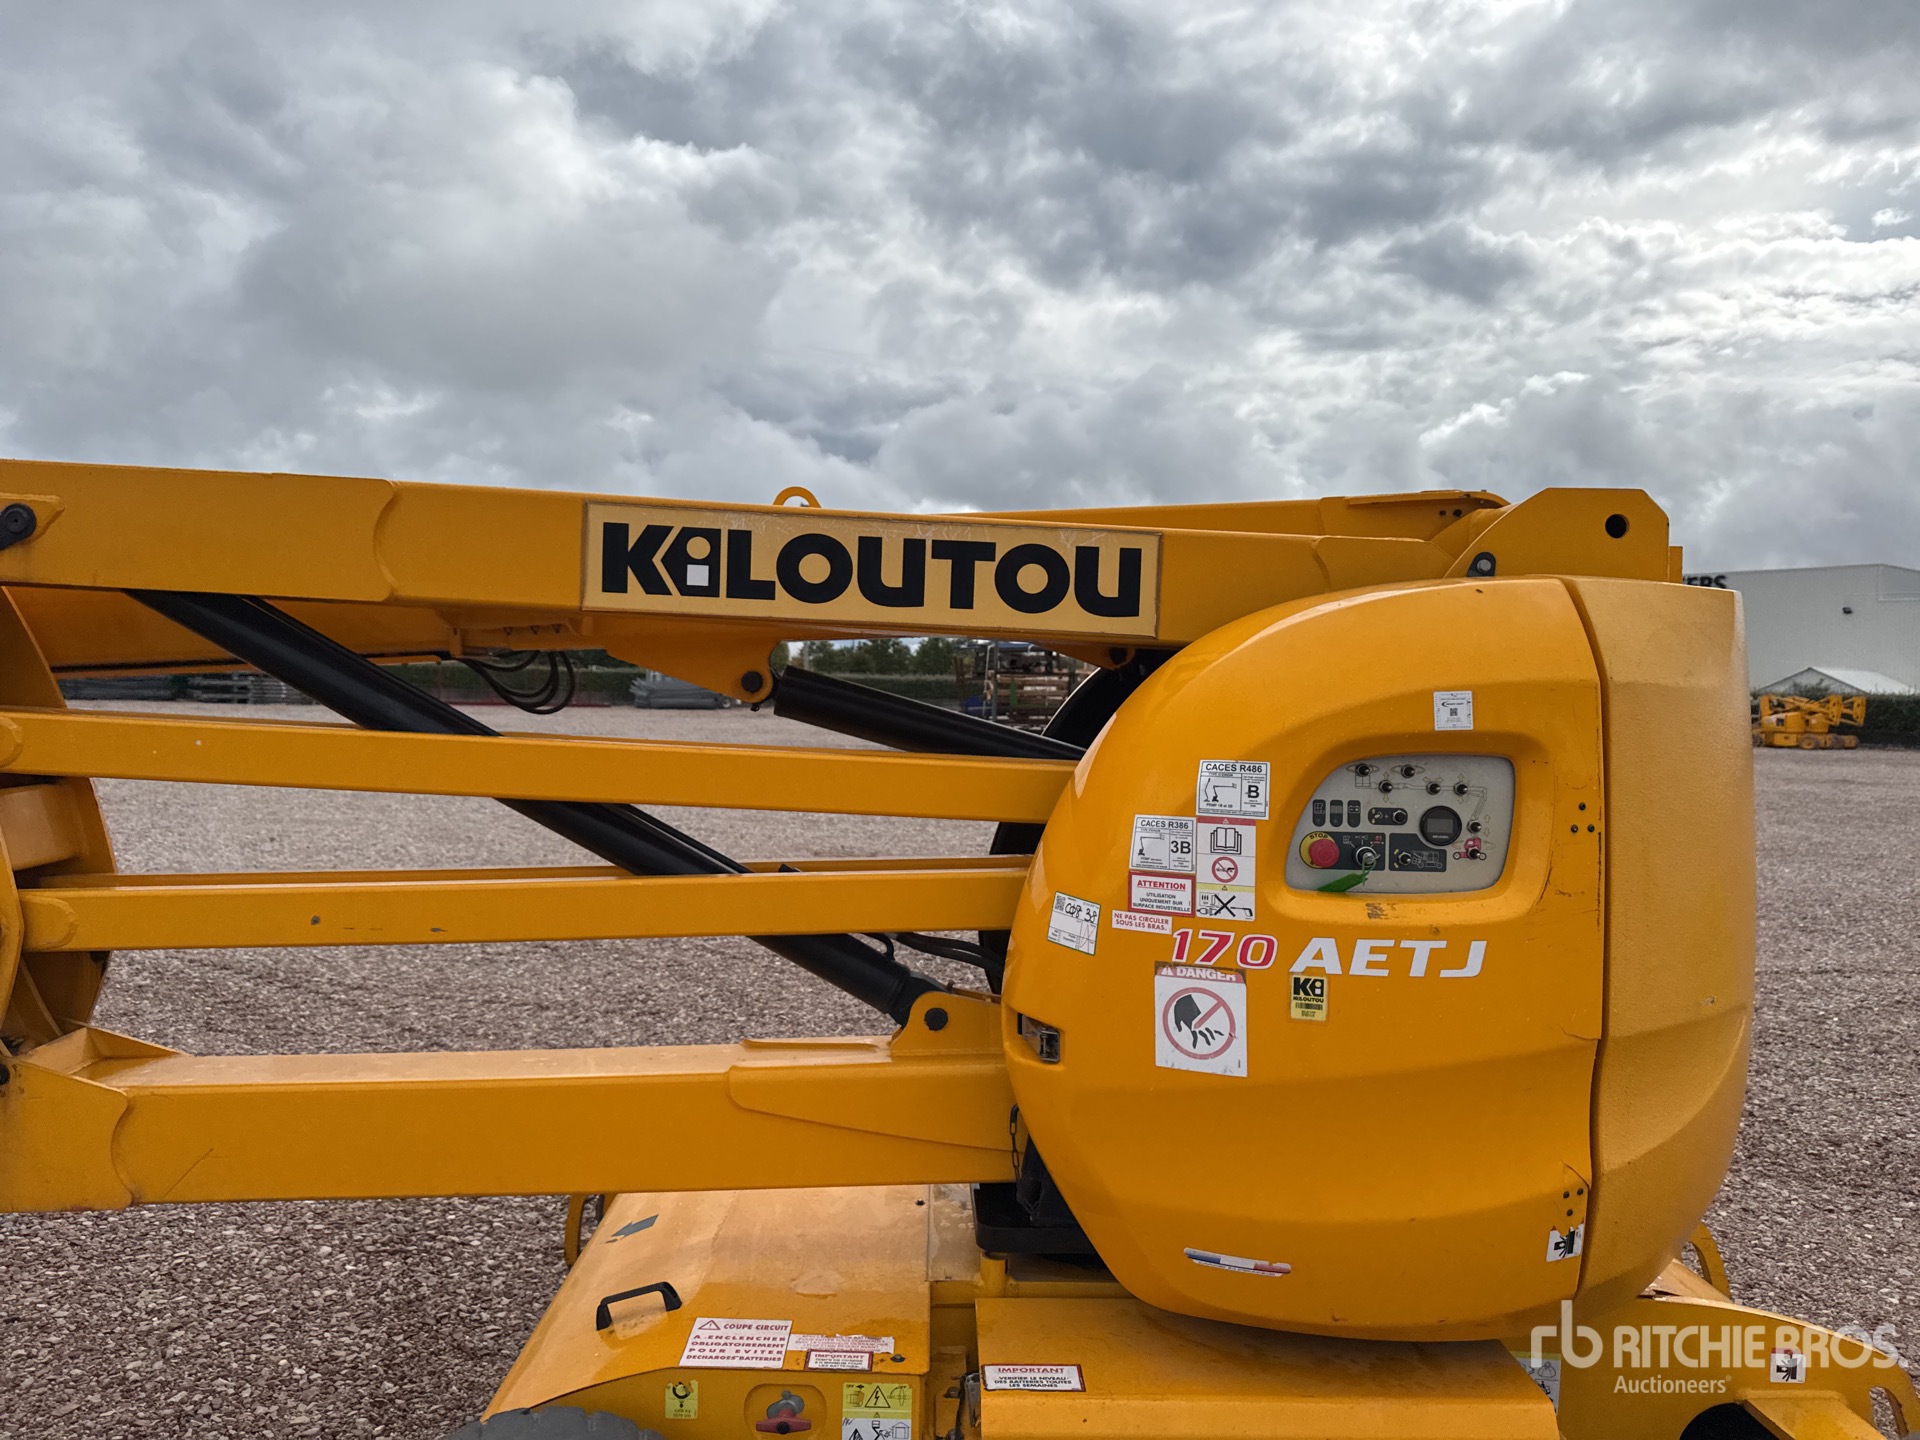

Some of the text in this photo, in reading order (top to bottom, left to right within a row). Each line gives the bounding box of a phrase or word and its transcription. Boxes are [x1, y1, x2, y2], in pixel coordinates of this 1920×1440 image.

[1205, 763, 1263, 773] CACES R486
[1247, 784, 1260, 799] B
[1140, 819, 1189, 829] CACES R386
[1170, 840, 1191, 854] 3B
[1137, 880, 1186, 890] ATTENTION
[1139, 897, 1171, 905] UNIQUEMENT
[1155, 904, 1190, 912] INDUSTRIELLE
[1138, 916, 1169, 925] CIRCULER
[1147, 923, 1167, 931] BRAS.
[1171, 928, 1488, 978] 170 AETJ
